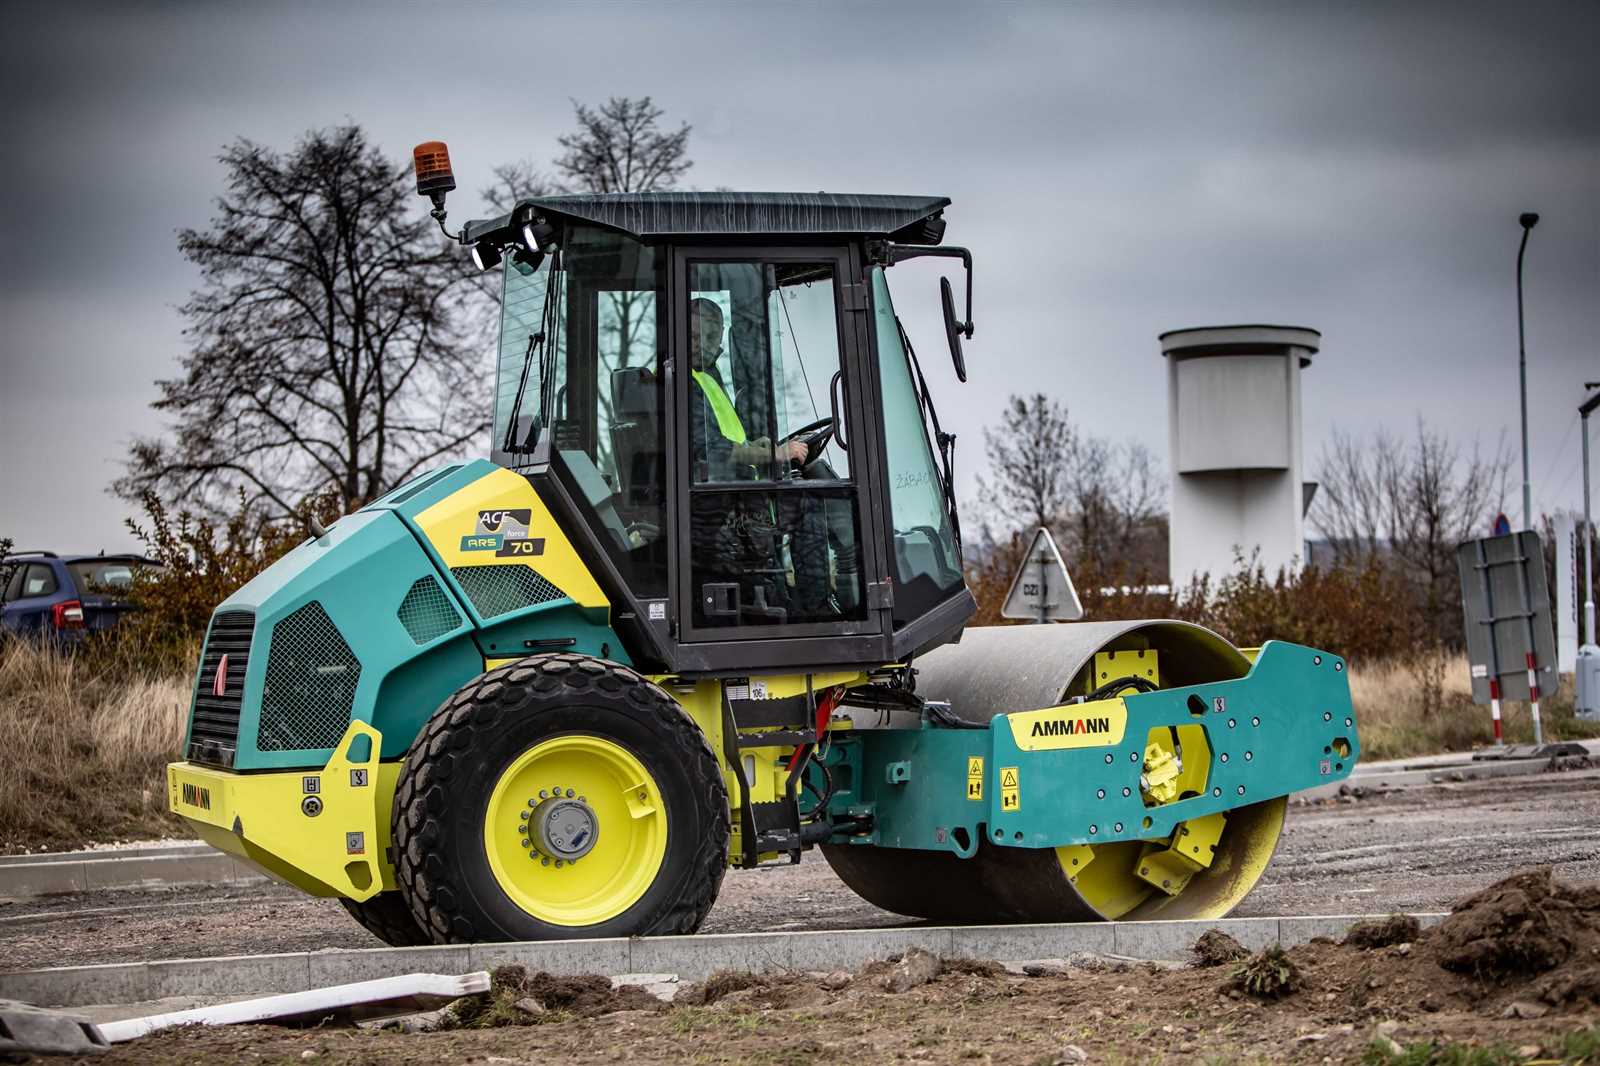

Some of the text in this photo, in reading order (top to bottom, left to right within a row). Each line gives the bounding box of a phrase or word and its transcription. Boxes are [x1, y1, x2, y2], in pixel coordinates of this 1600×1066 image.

[467, 538, 497, 548] ARS
[511, 541, 534, 554] 70
[1031, 718, 1110, 737] AMMANN
[182, 782, 211, 811] AMMANN
